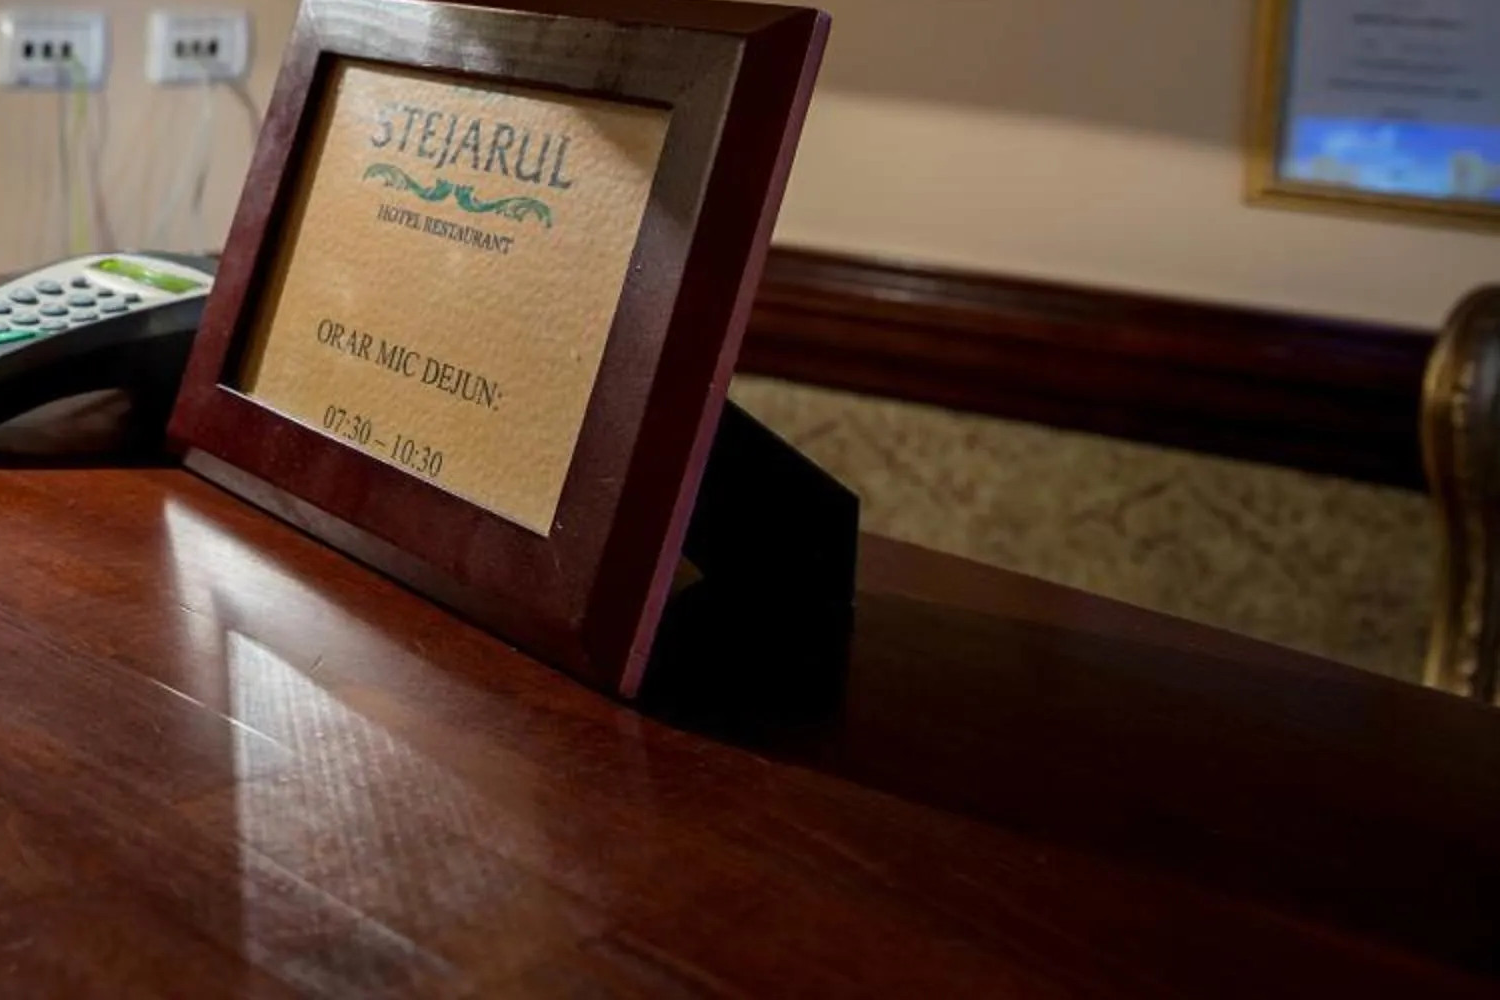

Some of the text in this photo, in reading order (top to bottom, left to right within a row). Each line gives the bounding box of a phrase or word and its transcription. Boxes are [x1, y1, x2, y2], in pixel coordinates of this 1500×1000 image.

[370, 102, 573, 190] STEJARUL
[377, 203, 515, 256] HOTEL RESTAURANT
[317, 318, 504, 412] ORAR MIC DEJUN:
[323, 404, 372, 446] 07:30
[389, 433, 444, 478] 10:30
